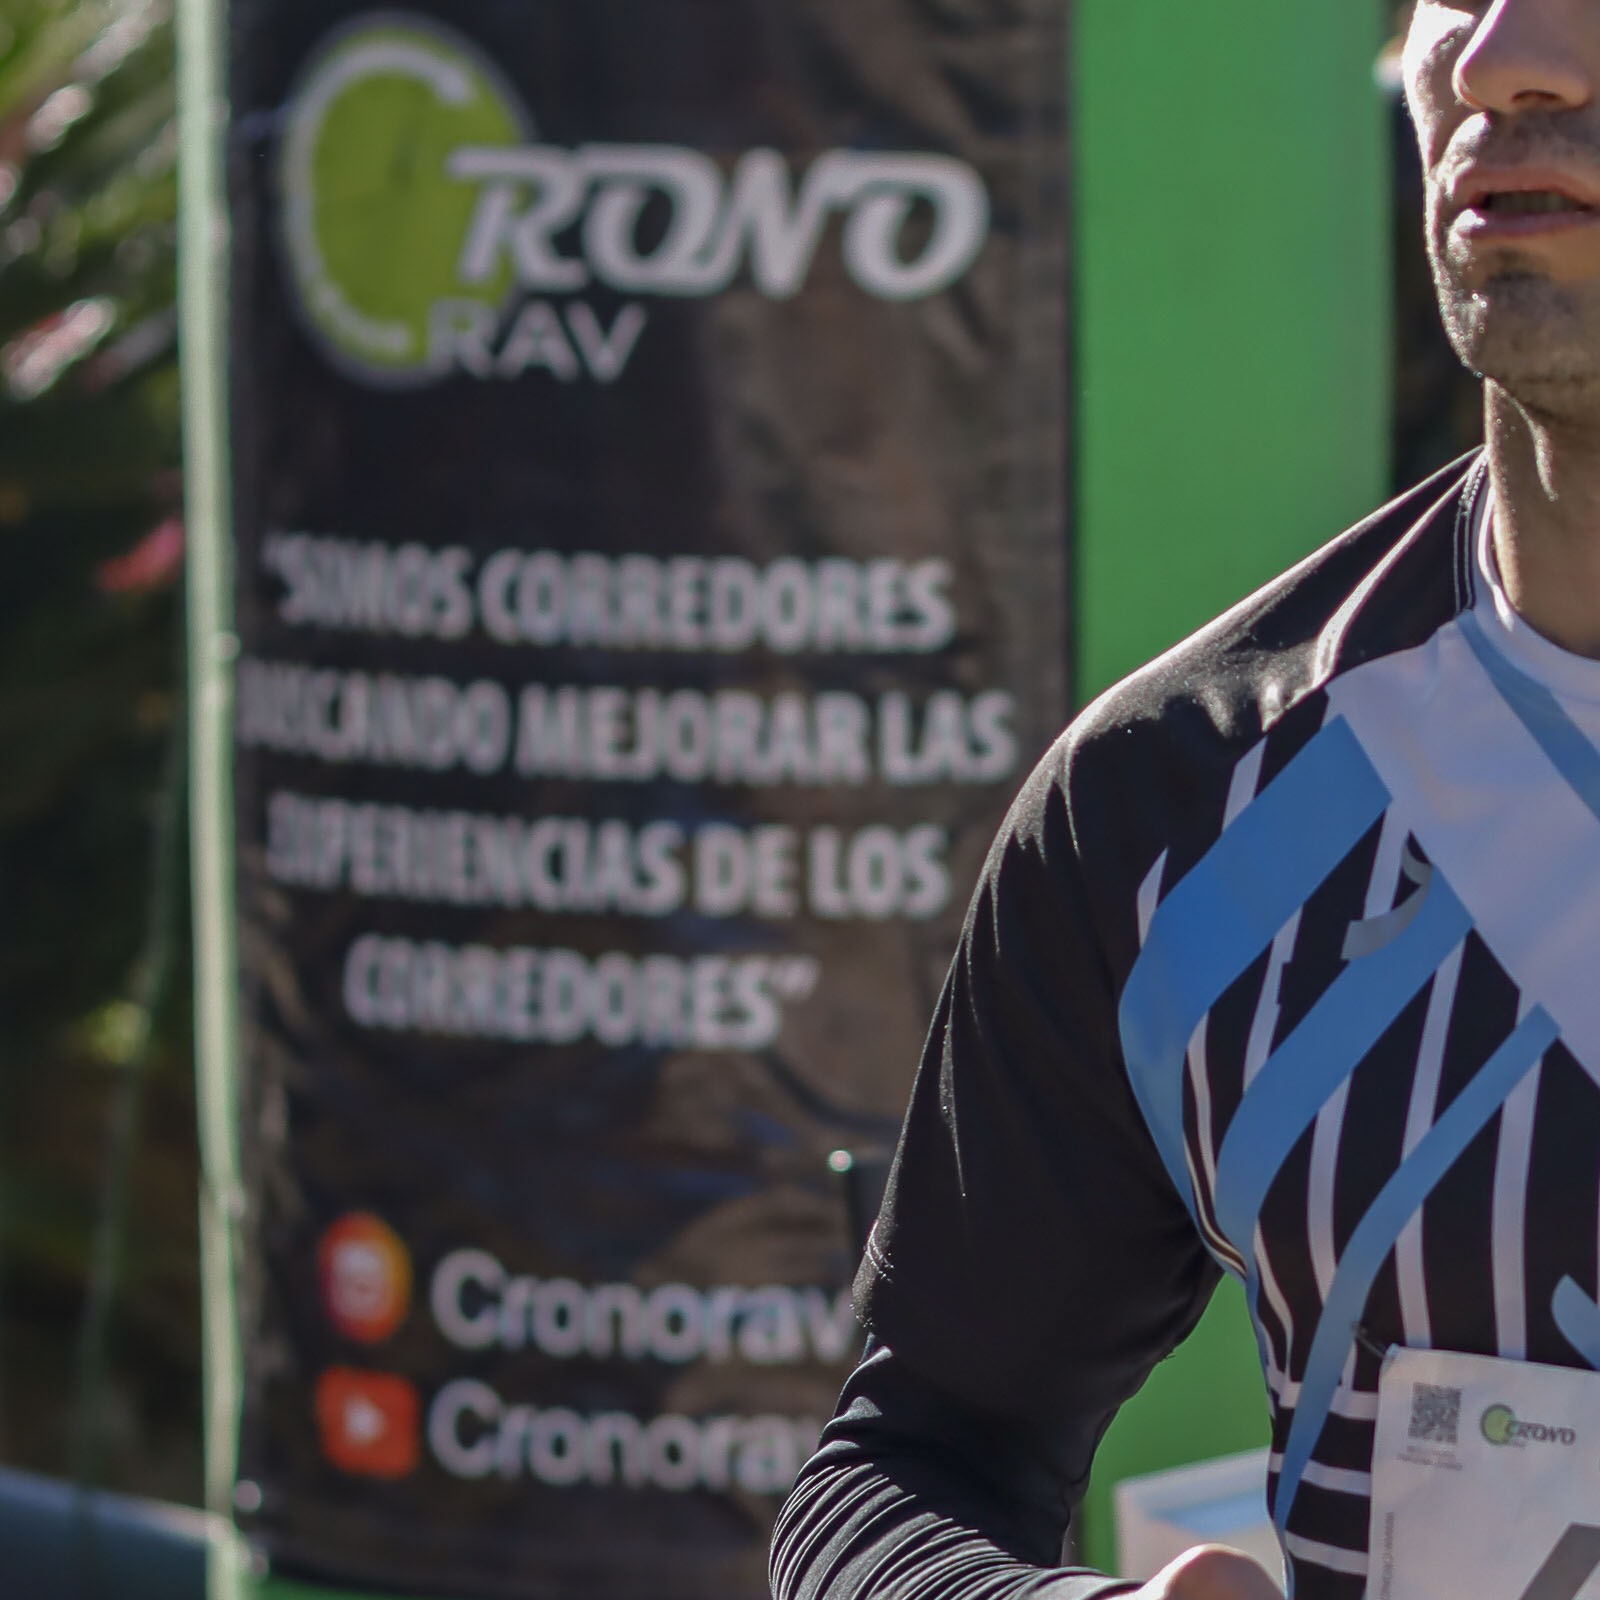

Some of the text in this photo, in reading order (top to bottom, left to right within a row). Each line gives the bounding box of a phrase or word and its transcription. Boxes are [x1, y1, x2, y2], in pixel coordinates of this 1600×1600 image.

[428, 298, 647, 382] RAV
[478, 547, 957, 653] CORREDORES
[516, 682, 869, 788] MEJORAR
[877, 686, 1018, 786] LAS
[693, 821, 801, 919] DE
[807, 822, 953, 921] LOS
[430, 1248, 857, 1366] Cronorav
